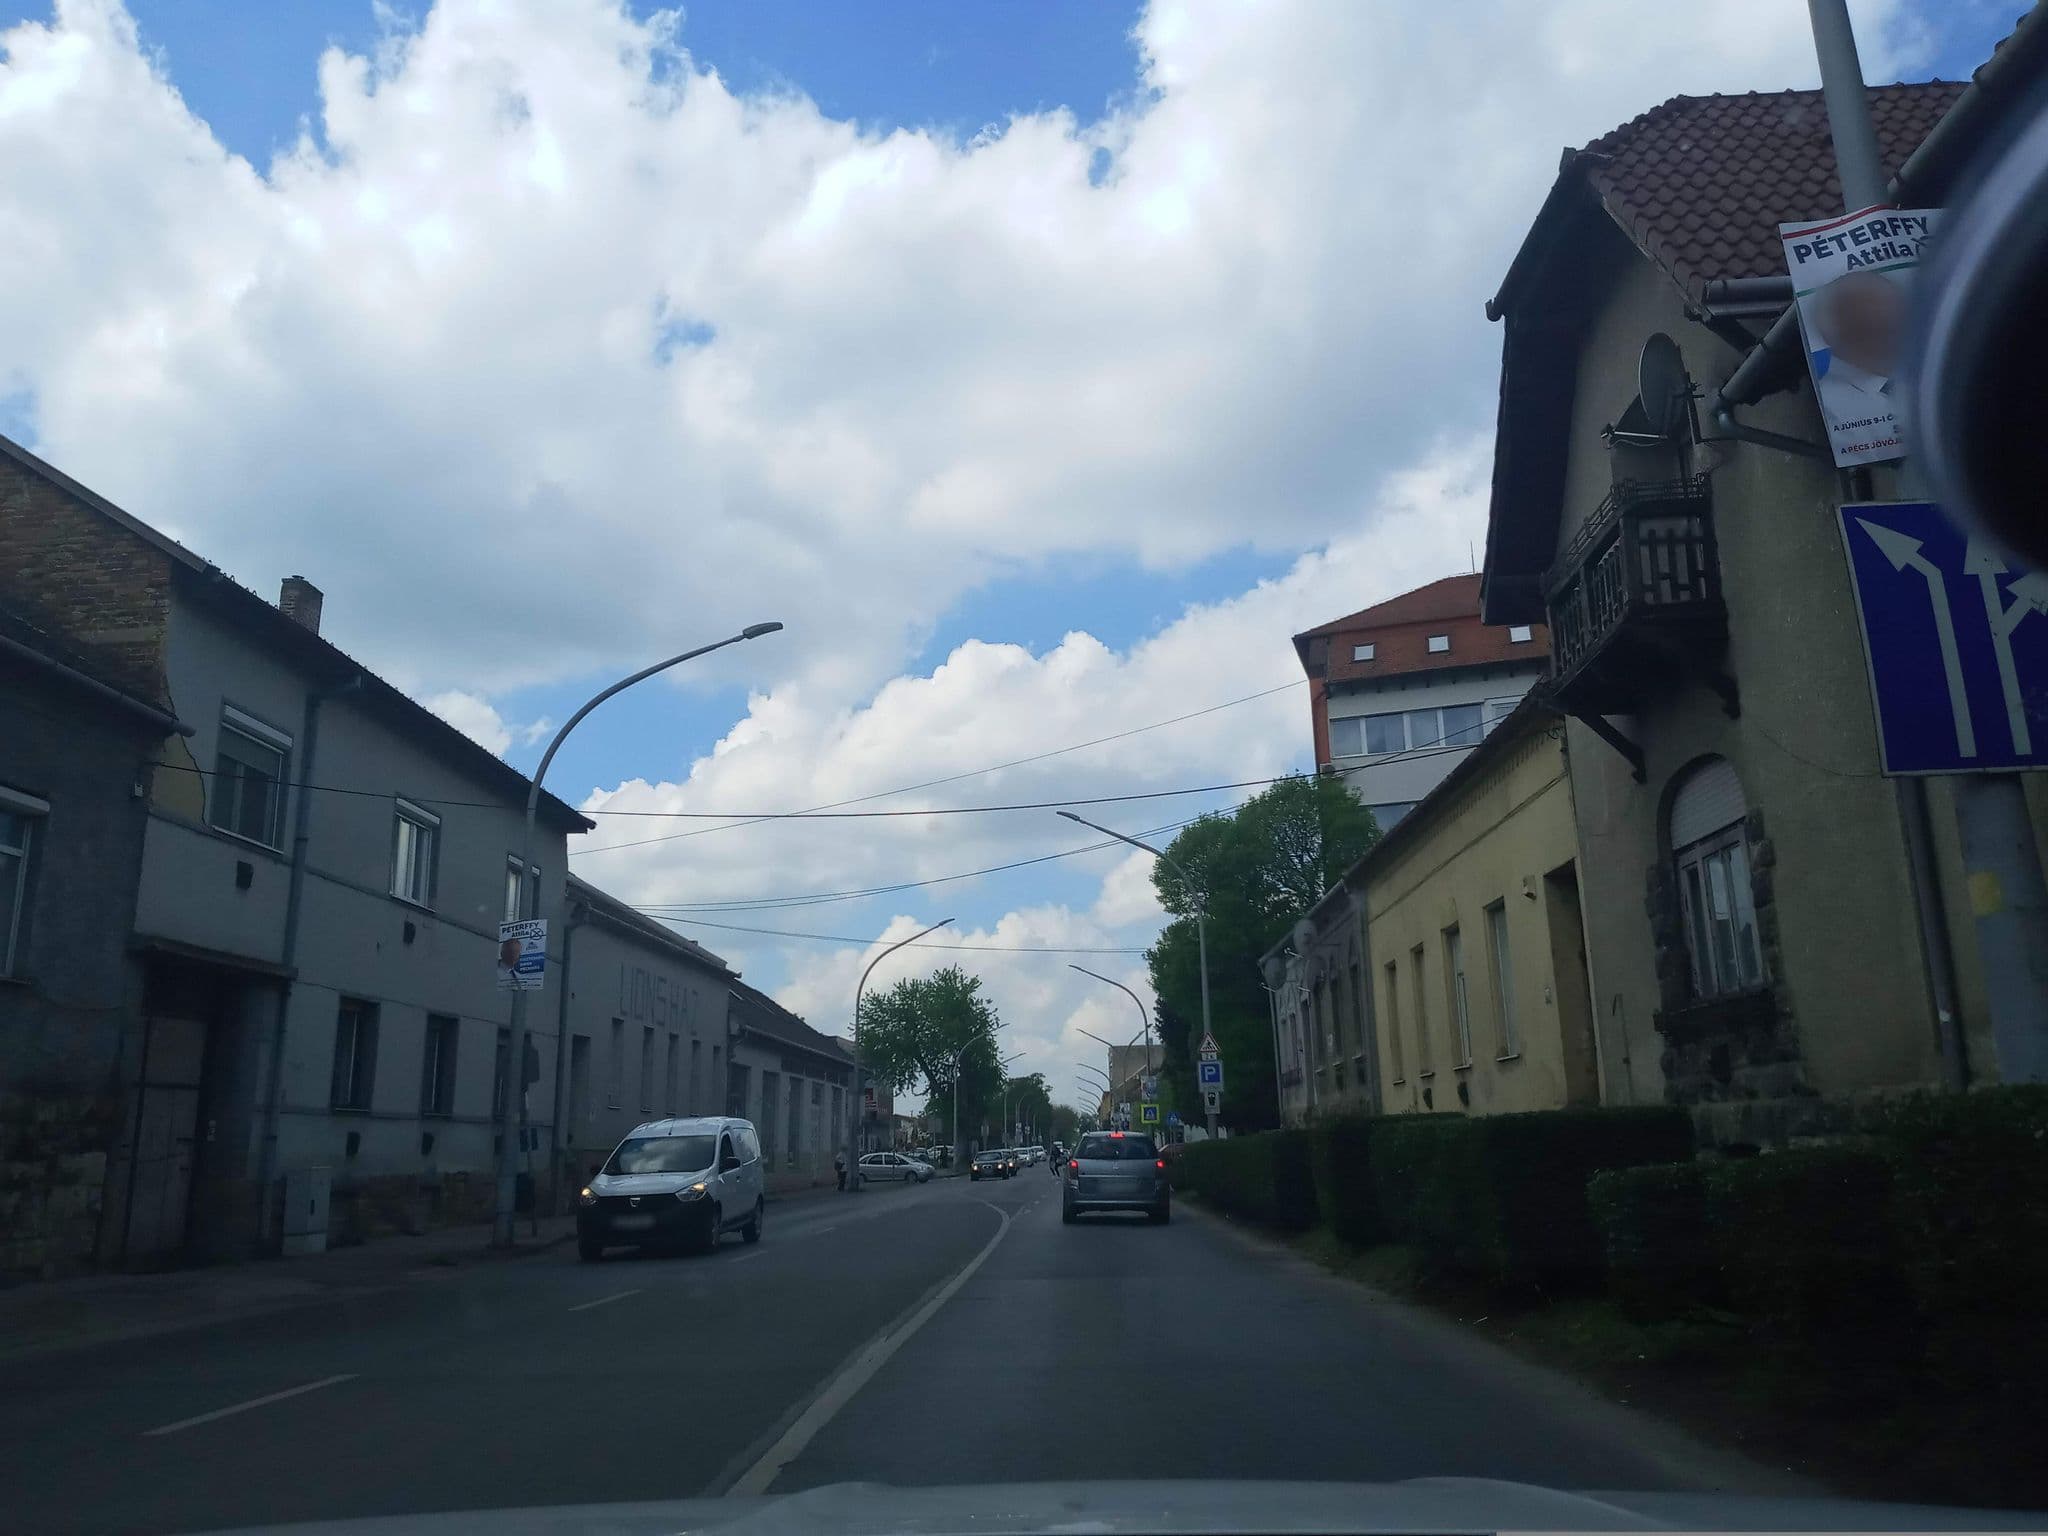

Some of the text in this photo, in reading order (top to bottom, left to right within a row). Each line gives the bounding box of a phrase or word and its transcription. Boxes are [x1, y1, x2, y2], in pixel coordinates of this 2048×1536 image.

[1793, 216, 1928, 264] PÉTERFFY
[1847, 241, 1914, 271] Attila
[1840, 419, 1873, 431] JÚNIUS
[1204, 1065, 1216, 1081] P
